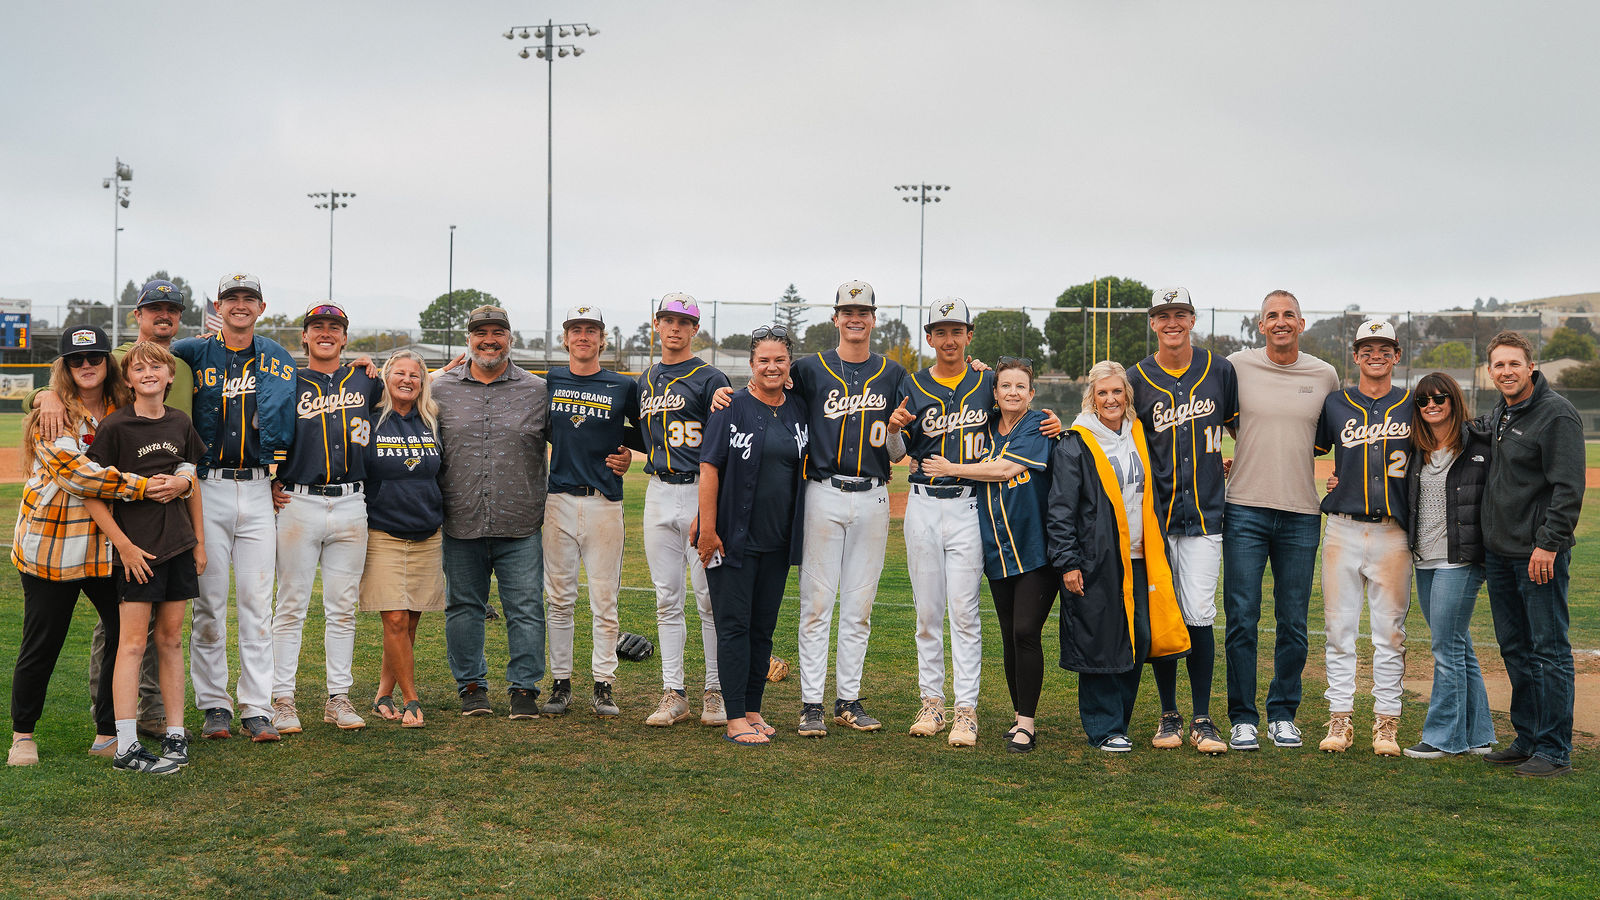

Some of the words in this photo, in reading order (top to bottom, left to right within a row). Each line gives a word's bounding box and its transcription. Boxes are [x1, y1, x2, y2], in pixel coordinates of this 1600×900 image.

[222, 369, 256, 398] agle
[553, 389, 580, 399] ARROYO
[581, 392, 613, 405] GRANDE
[297, 387, 365, 419] Eagles
[551, 402, 611, 419] BASEBALL
[640, 388, 686, 420] Eagles
[824, 388, 887, 420] Eagles
[1153, 395, 1216, 432] Eagles
[350, 416, 371, 447] 28
[668, 420, 703, 448] 35
[869, 420, 886, 448] 0
[922, 404, 988, 438] Eagles
[1340, 416, 1411, 449] Eagles
[137, 443, 162, 458] SANTA
[964, 432, 985, 460] 10
[1204, 425, 1221, 454] 14
[1387, 449, 1407, 479] 2
